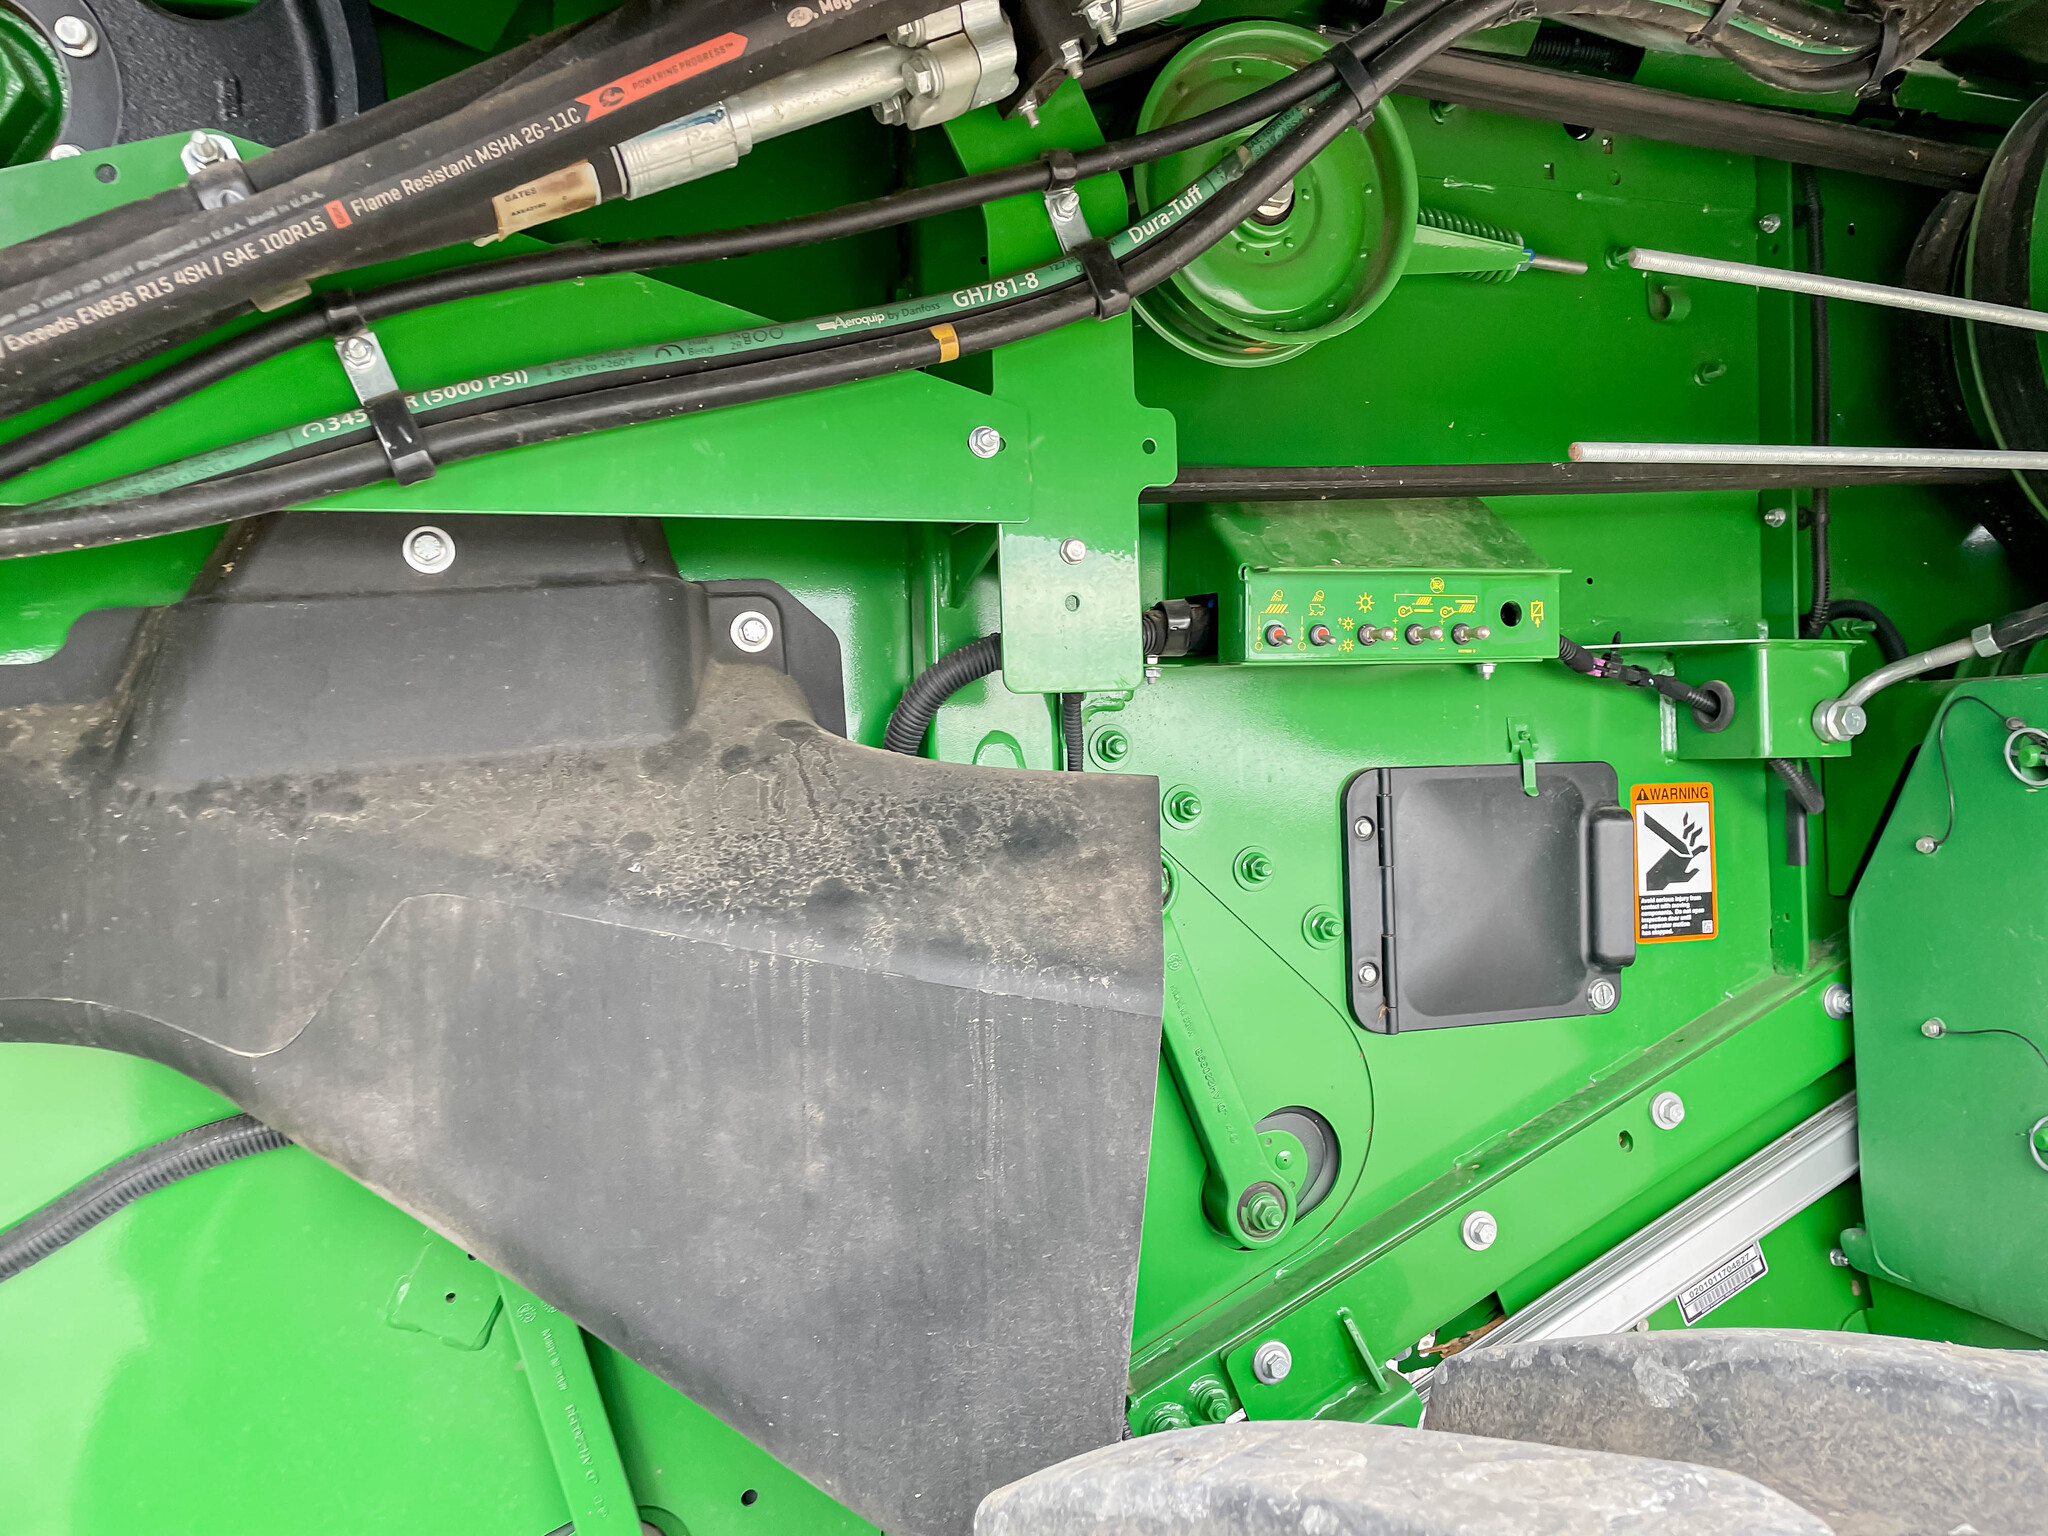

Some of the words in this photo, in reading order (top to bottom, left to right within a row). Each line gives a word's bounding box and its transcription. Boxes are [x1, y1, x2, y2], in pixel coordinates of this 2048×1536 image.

[631, 65, 679, 90] POWERING
[351, 185, 401, 216] Flame
[402, 155, 477, 195] Resistant
[476, 133, 523, 165] MSHA
[521, 107, 580, 144] 2G-11C
[503, 186, 537, 202] GATES
[1128, 185, 1203, 243] Dura-Tuff
[6, 316, 76, 351] Exceeds
[78, 290, 137, 324] EN856
[138, 275, 174, 302] R15
[175, 262, 212, 286] 4SH
[224, 243, 258, 269] SAE
[261, 215, 328, 254] 100R15
[954, 273, 1038, 308] GH781-8
[832, 308, 885, 331] Aeroquip
[886, 309, 900, 320] by
[901, 301, 941, 317] Danfoss
[421, 378, 485, 407] (5000
[487, 368, 529, 390] PSI)
[1649, 786, 1708, 799] WARNING
[1689, 1253, 1749, 1298] 0201011704827
